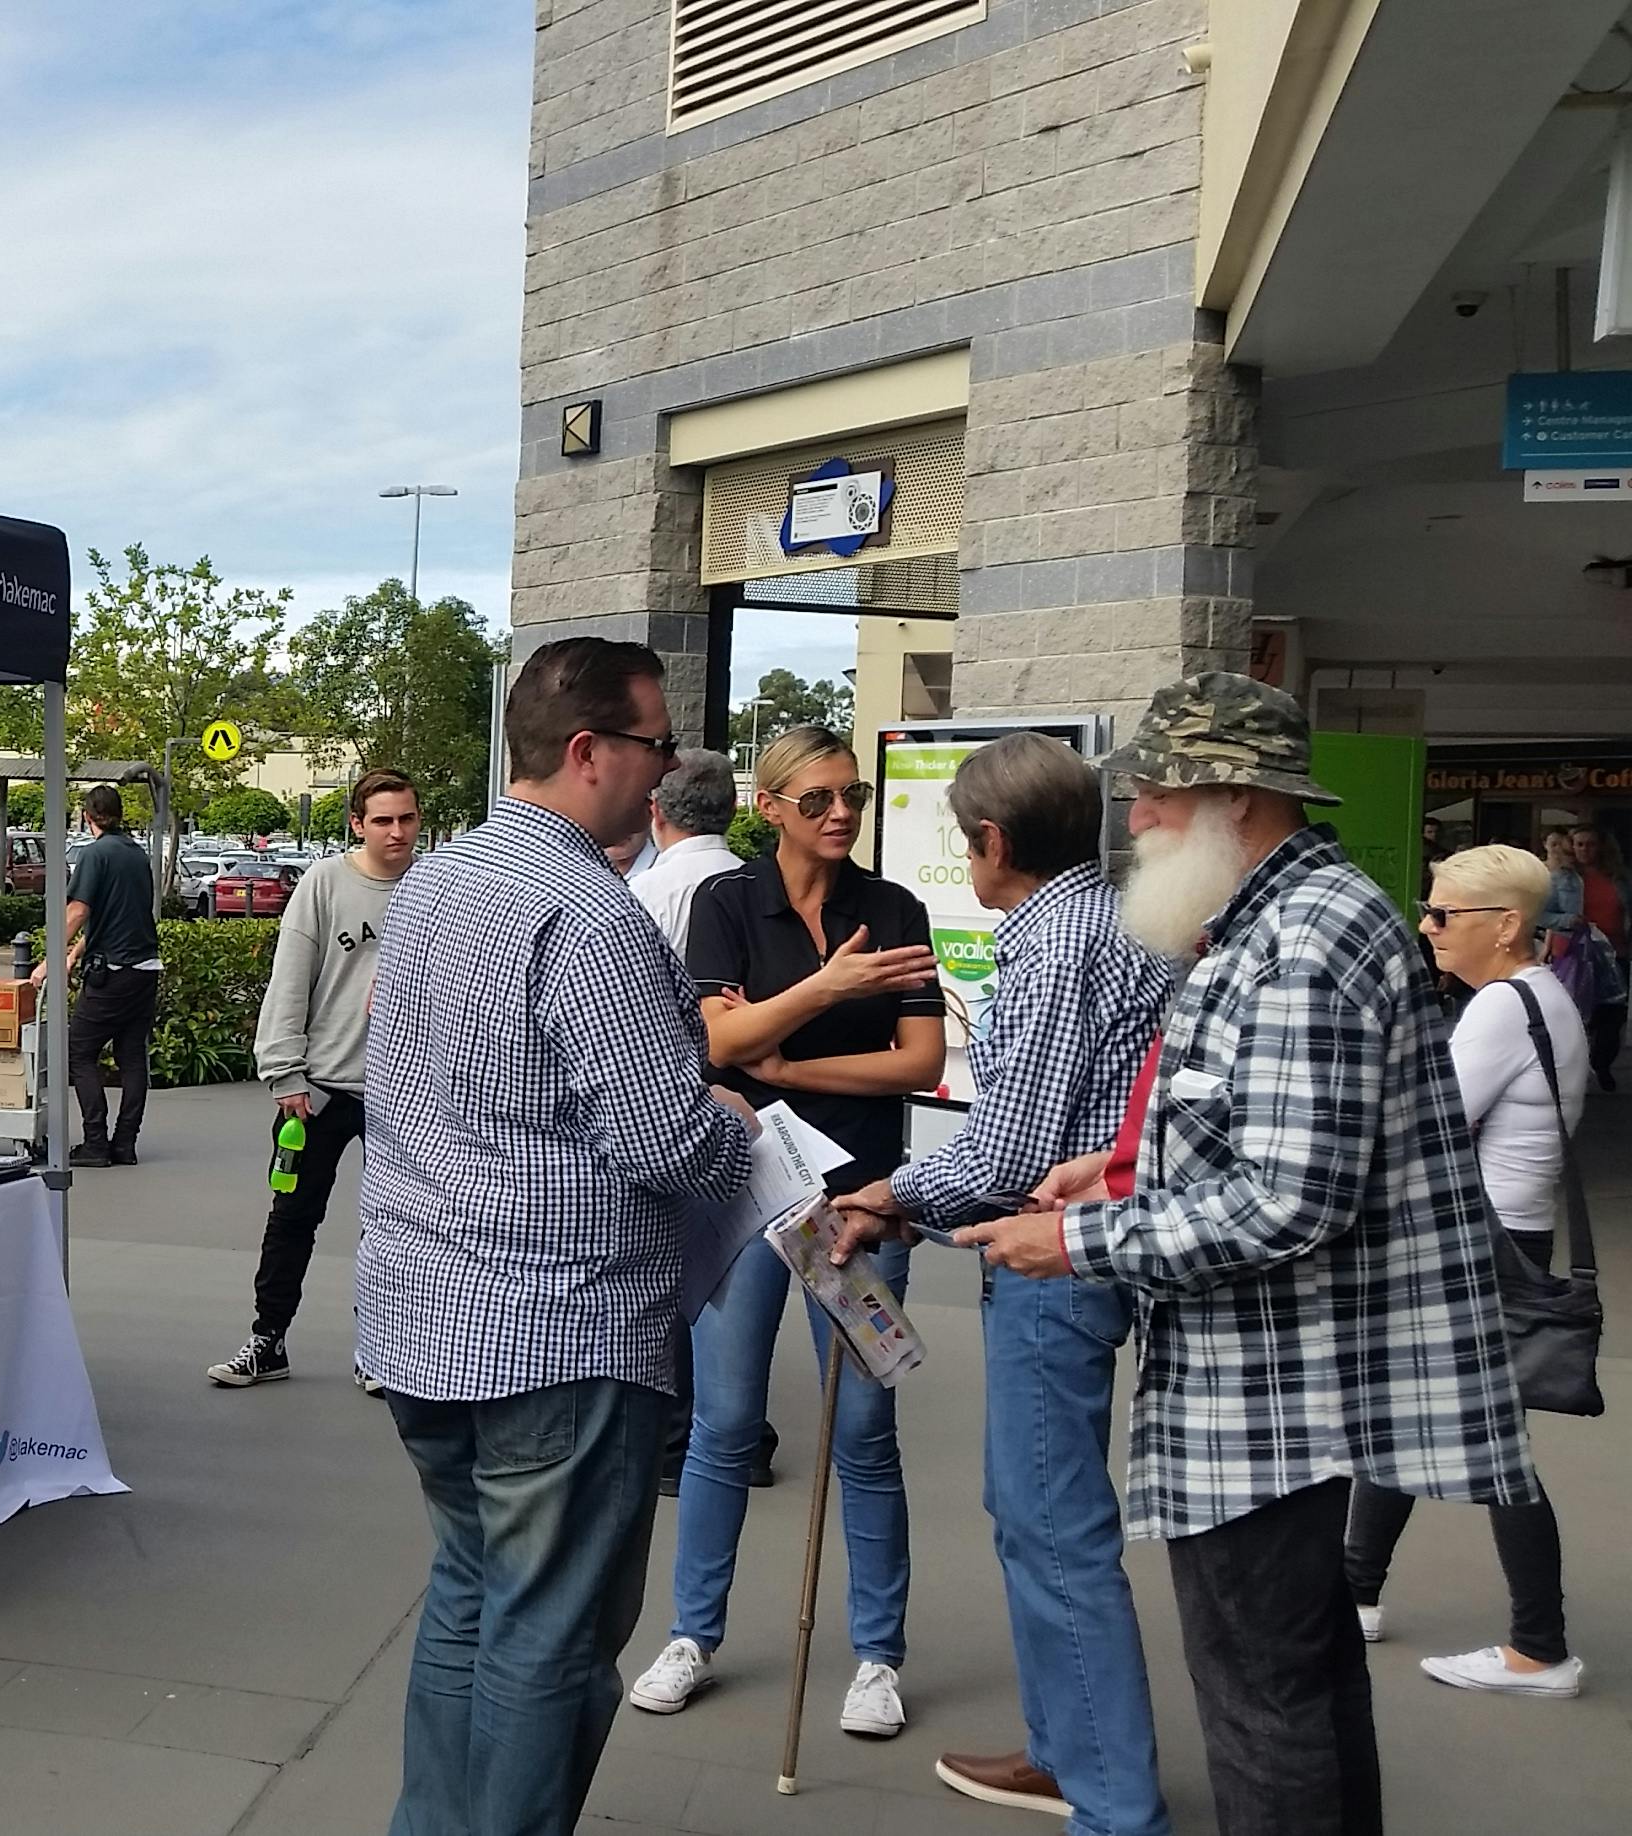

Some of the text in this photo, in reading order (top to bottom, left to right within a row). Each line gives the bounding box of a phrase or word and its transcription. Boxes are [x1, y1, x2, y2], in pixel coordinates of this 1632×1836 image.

[1550, 431, 1609, 441] Customer
[914, 760, 946, 770] Thicker
[948, 760, 956, 770] &
[1427, 768, 1632, 789] Gloria Jean's Cof
[777, 1126, 798, 1155] AROUND
[791, 1153, 806, 1170] THE
[799, 1169, 815, 1187] CITY
